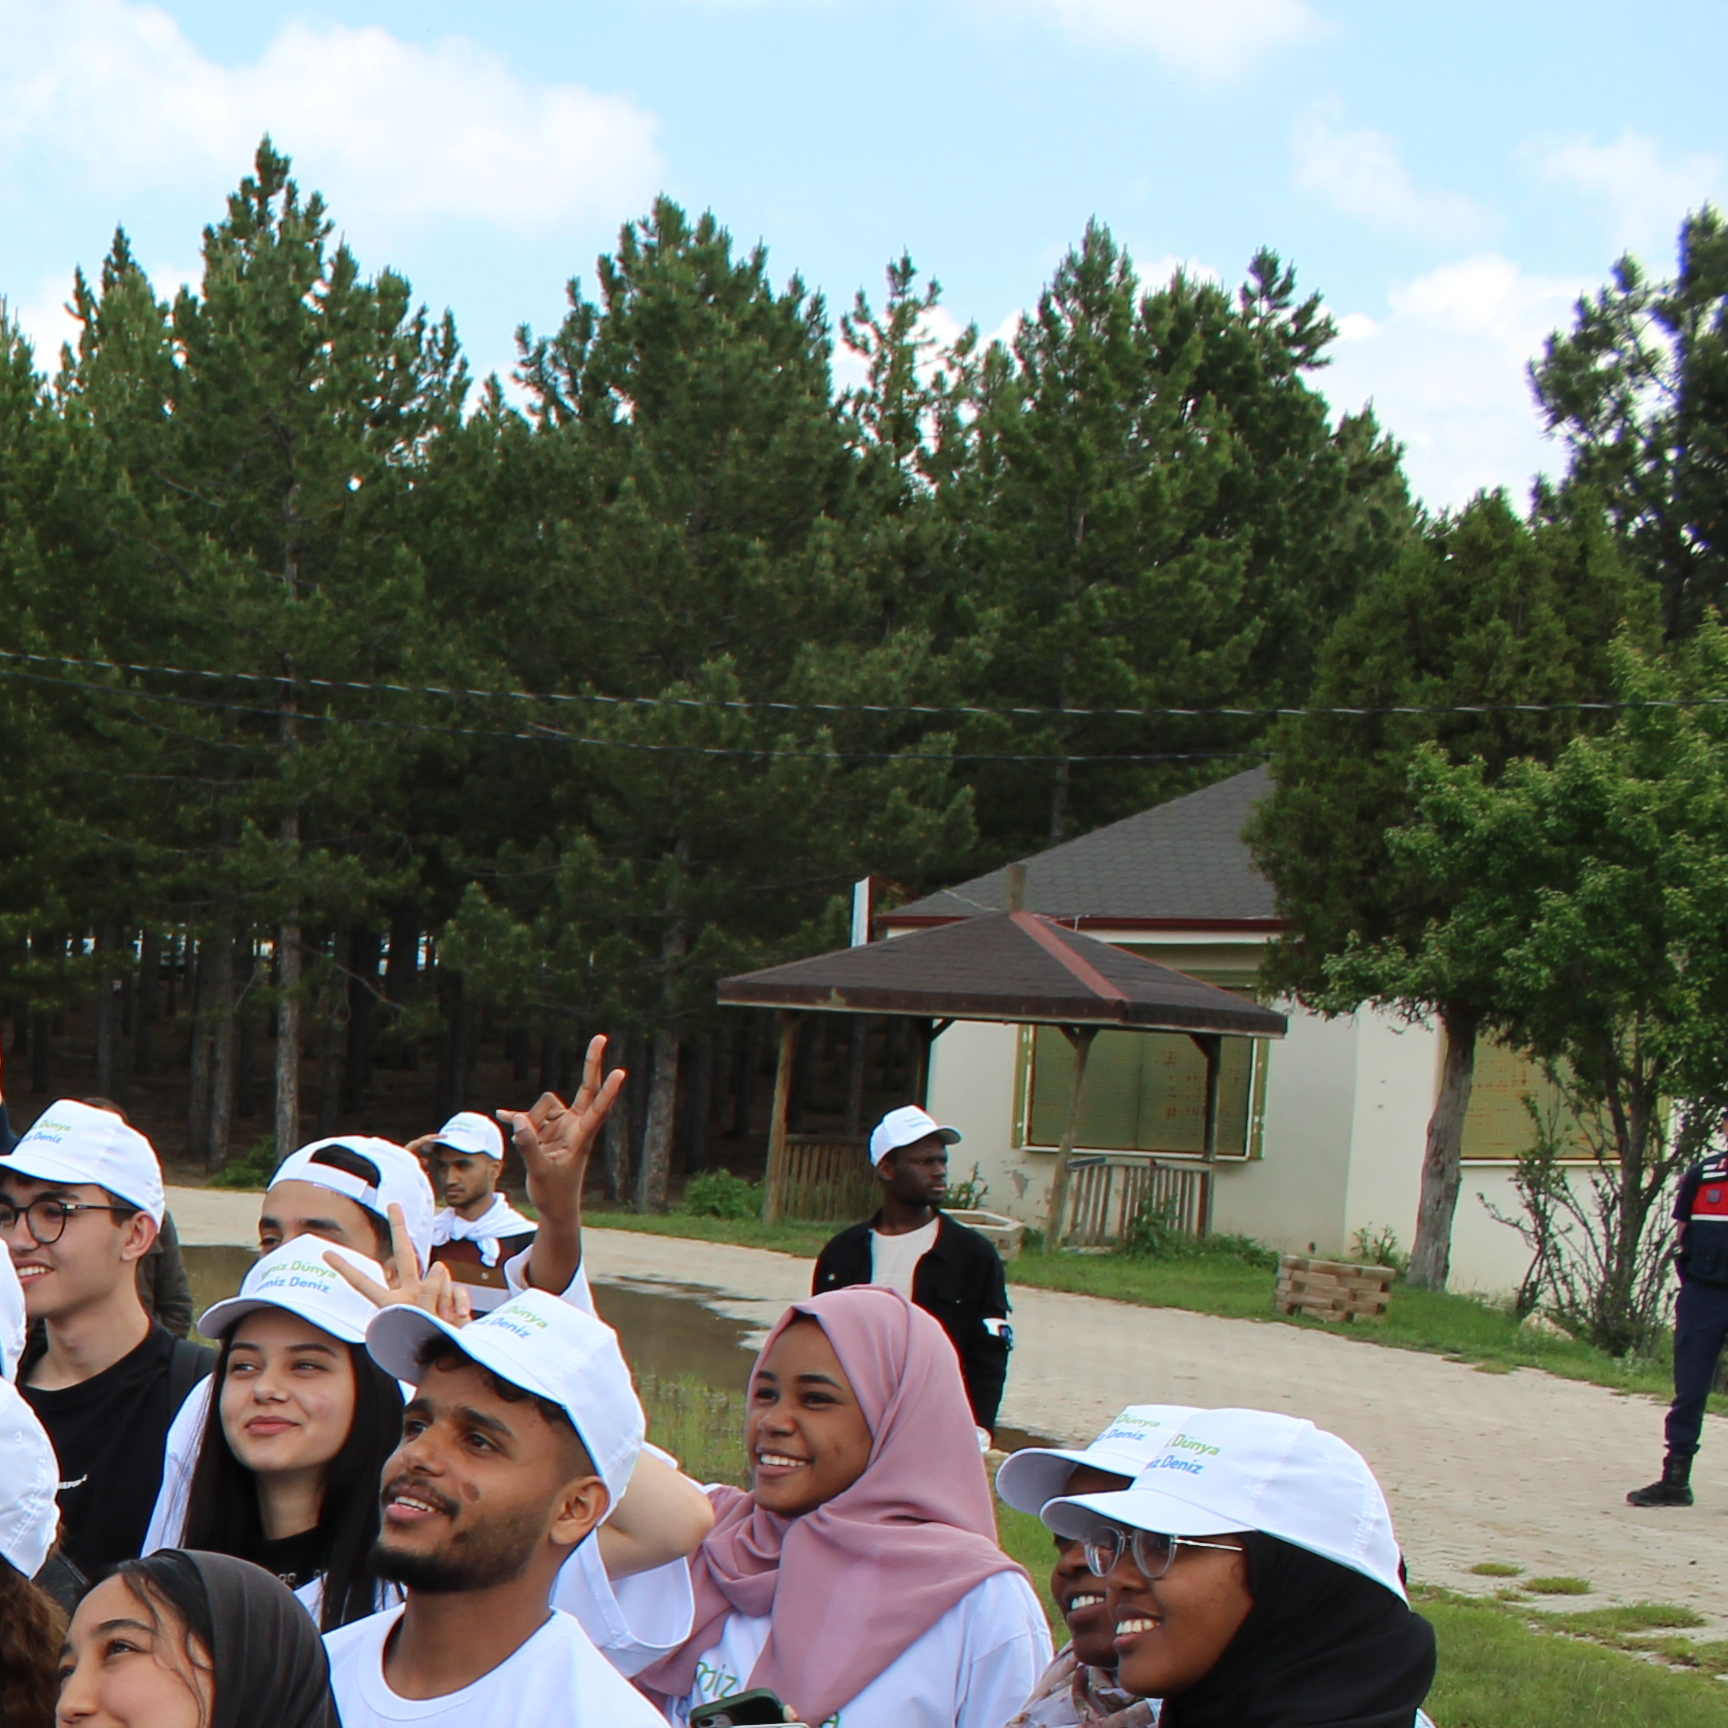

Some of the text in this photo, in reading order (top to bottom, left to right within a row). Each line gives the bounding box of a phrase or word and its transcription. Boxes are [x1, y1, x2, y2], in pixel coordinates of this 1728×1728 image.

[38, 1119, 71, 1132] Dünya
[32, 1131, 63, 1145] Deniz
[290, 1260, 337, 1279] Dünya
[288, 1276, 331, 1294] Deniz
[504, 1305, 549, 1330] Dünya
[489, 1316, 531, 1340] Deniz
[1115, 1413, 1161, 1428] Dünya
[1106, 1428, 1146, 1441] Deniz
[1170, 1433, 1221, 1456] Dünya
[1160, 1454, 1204, 1475] Deniz
